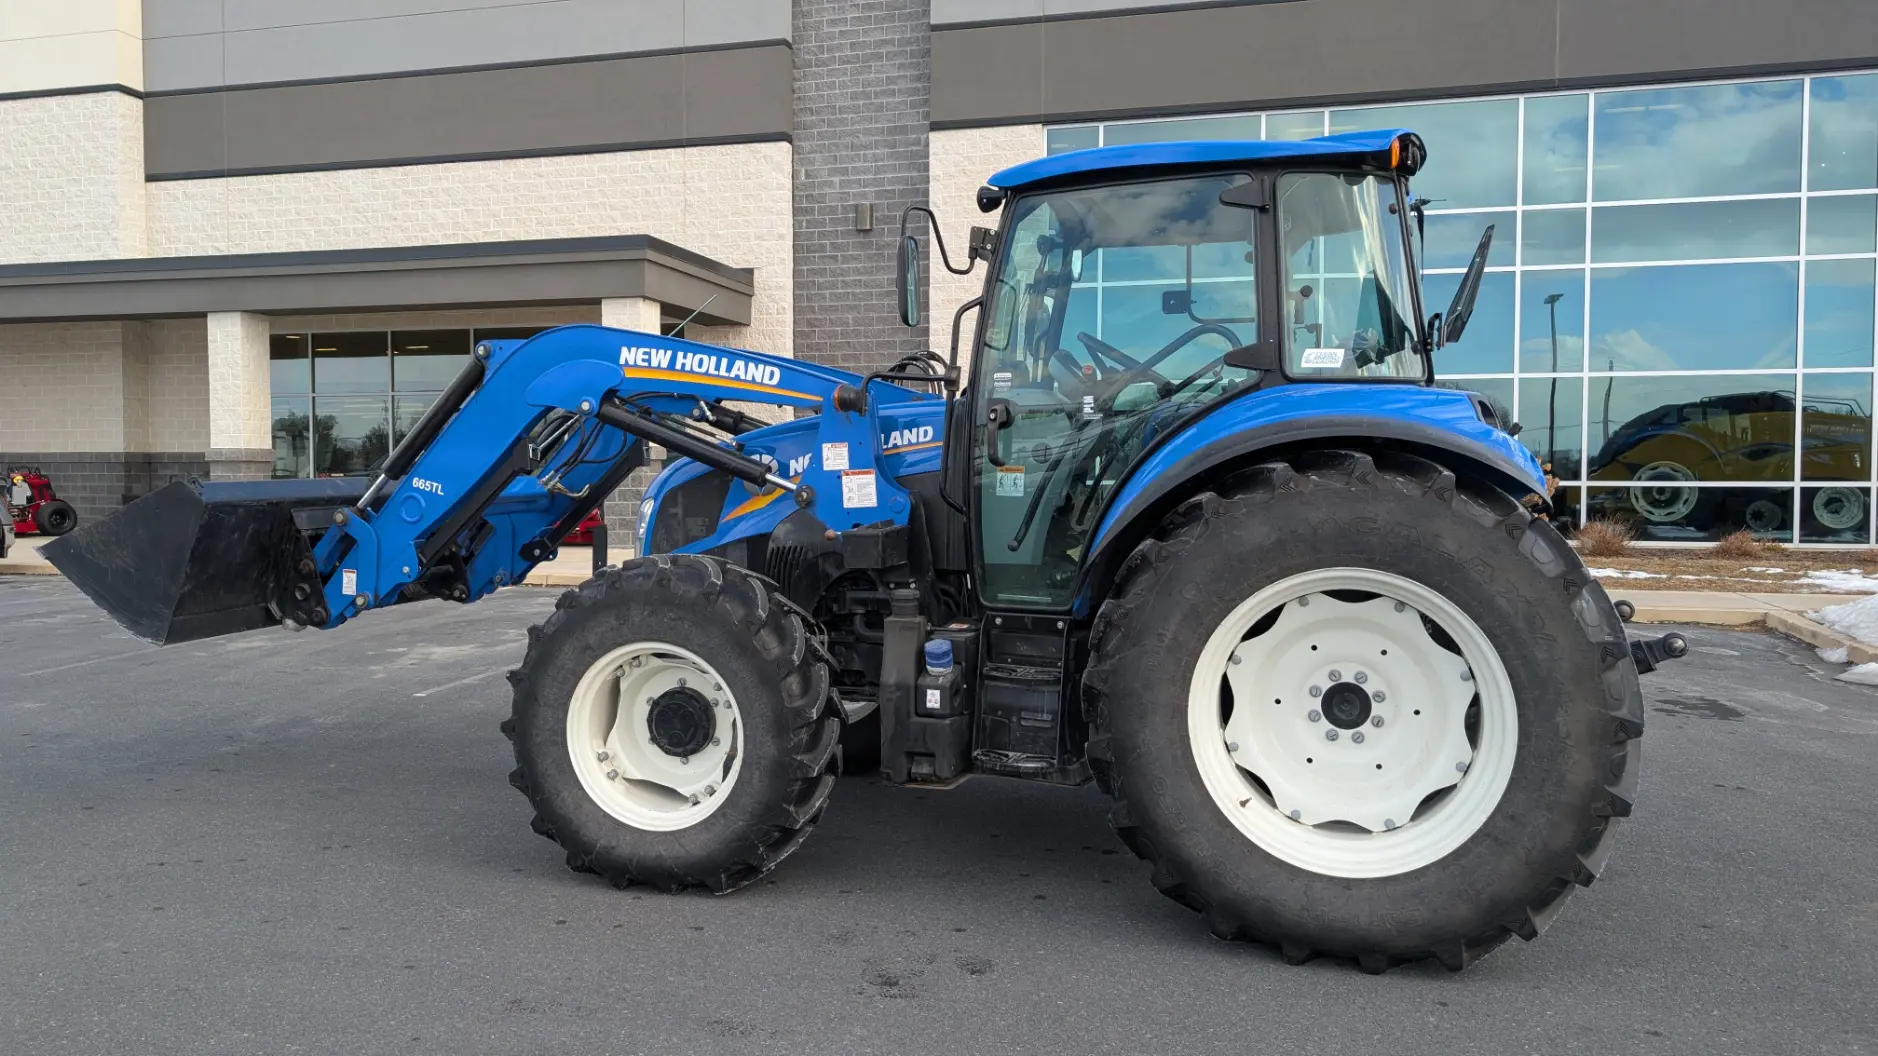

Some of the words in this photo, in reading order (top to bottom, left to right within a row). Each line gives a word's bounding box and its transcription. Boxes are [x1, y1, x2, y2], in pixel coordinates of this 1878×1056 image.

[619, 346, 672, 369] NEW
[675, 351, 780, 386] HOLLAND
[412, 477, 444, 496] 665TL
